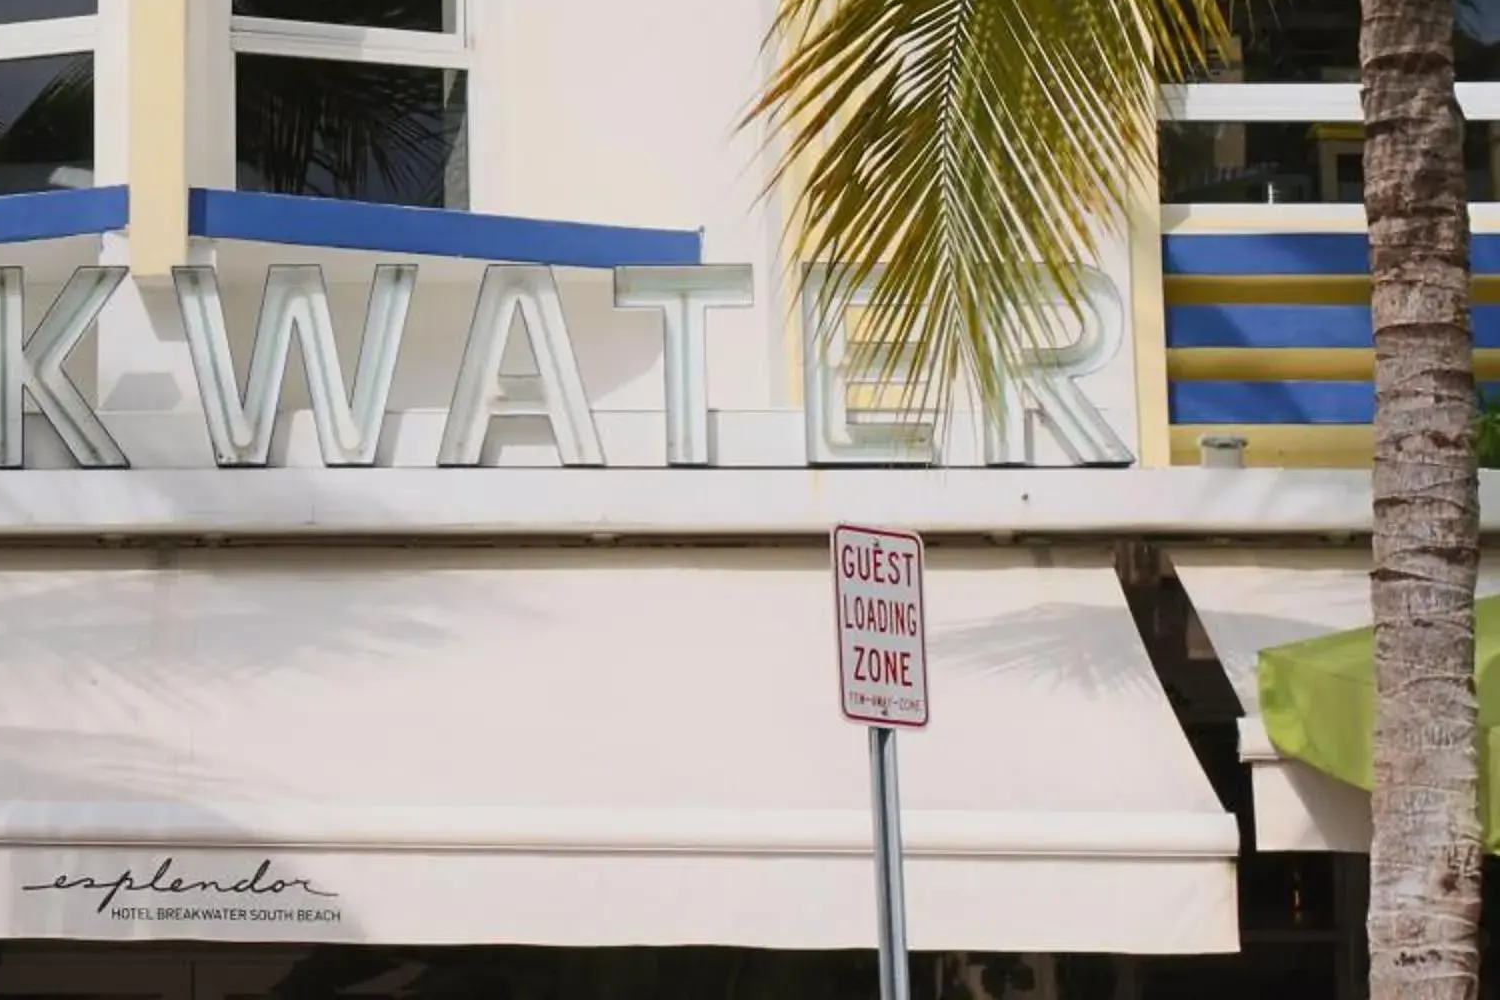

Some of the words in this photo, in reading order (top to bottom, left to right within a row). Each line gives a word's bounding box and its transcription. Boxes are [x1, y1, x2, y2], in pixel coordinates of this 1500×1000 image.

[841, 545, 914, 587] GUEST
[843, 594, 917, 637] LOADING
[853, 646, 913, 687] ZONE
[22, 858, 338, 913] esplendor
[111, 907, 153, 921] HOTEL
[157, 908, 247, 921] BREAKWATER
[250, 909, 293, 921] SOUTH
[297, 909, 341, 922] BEACH
